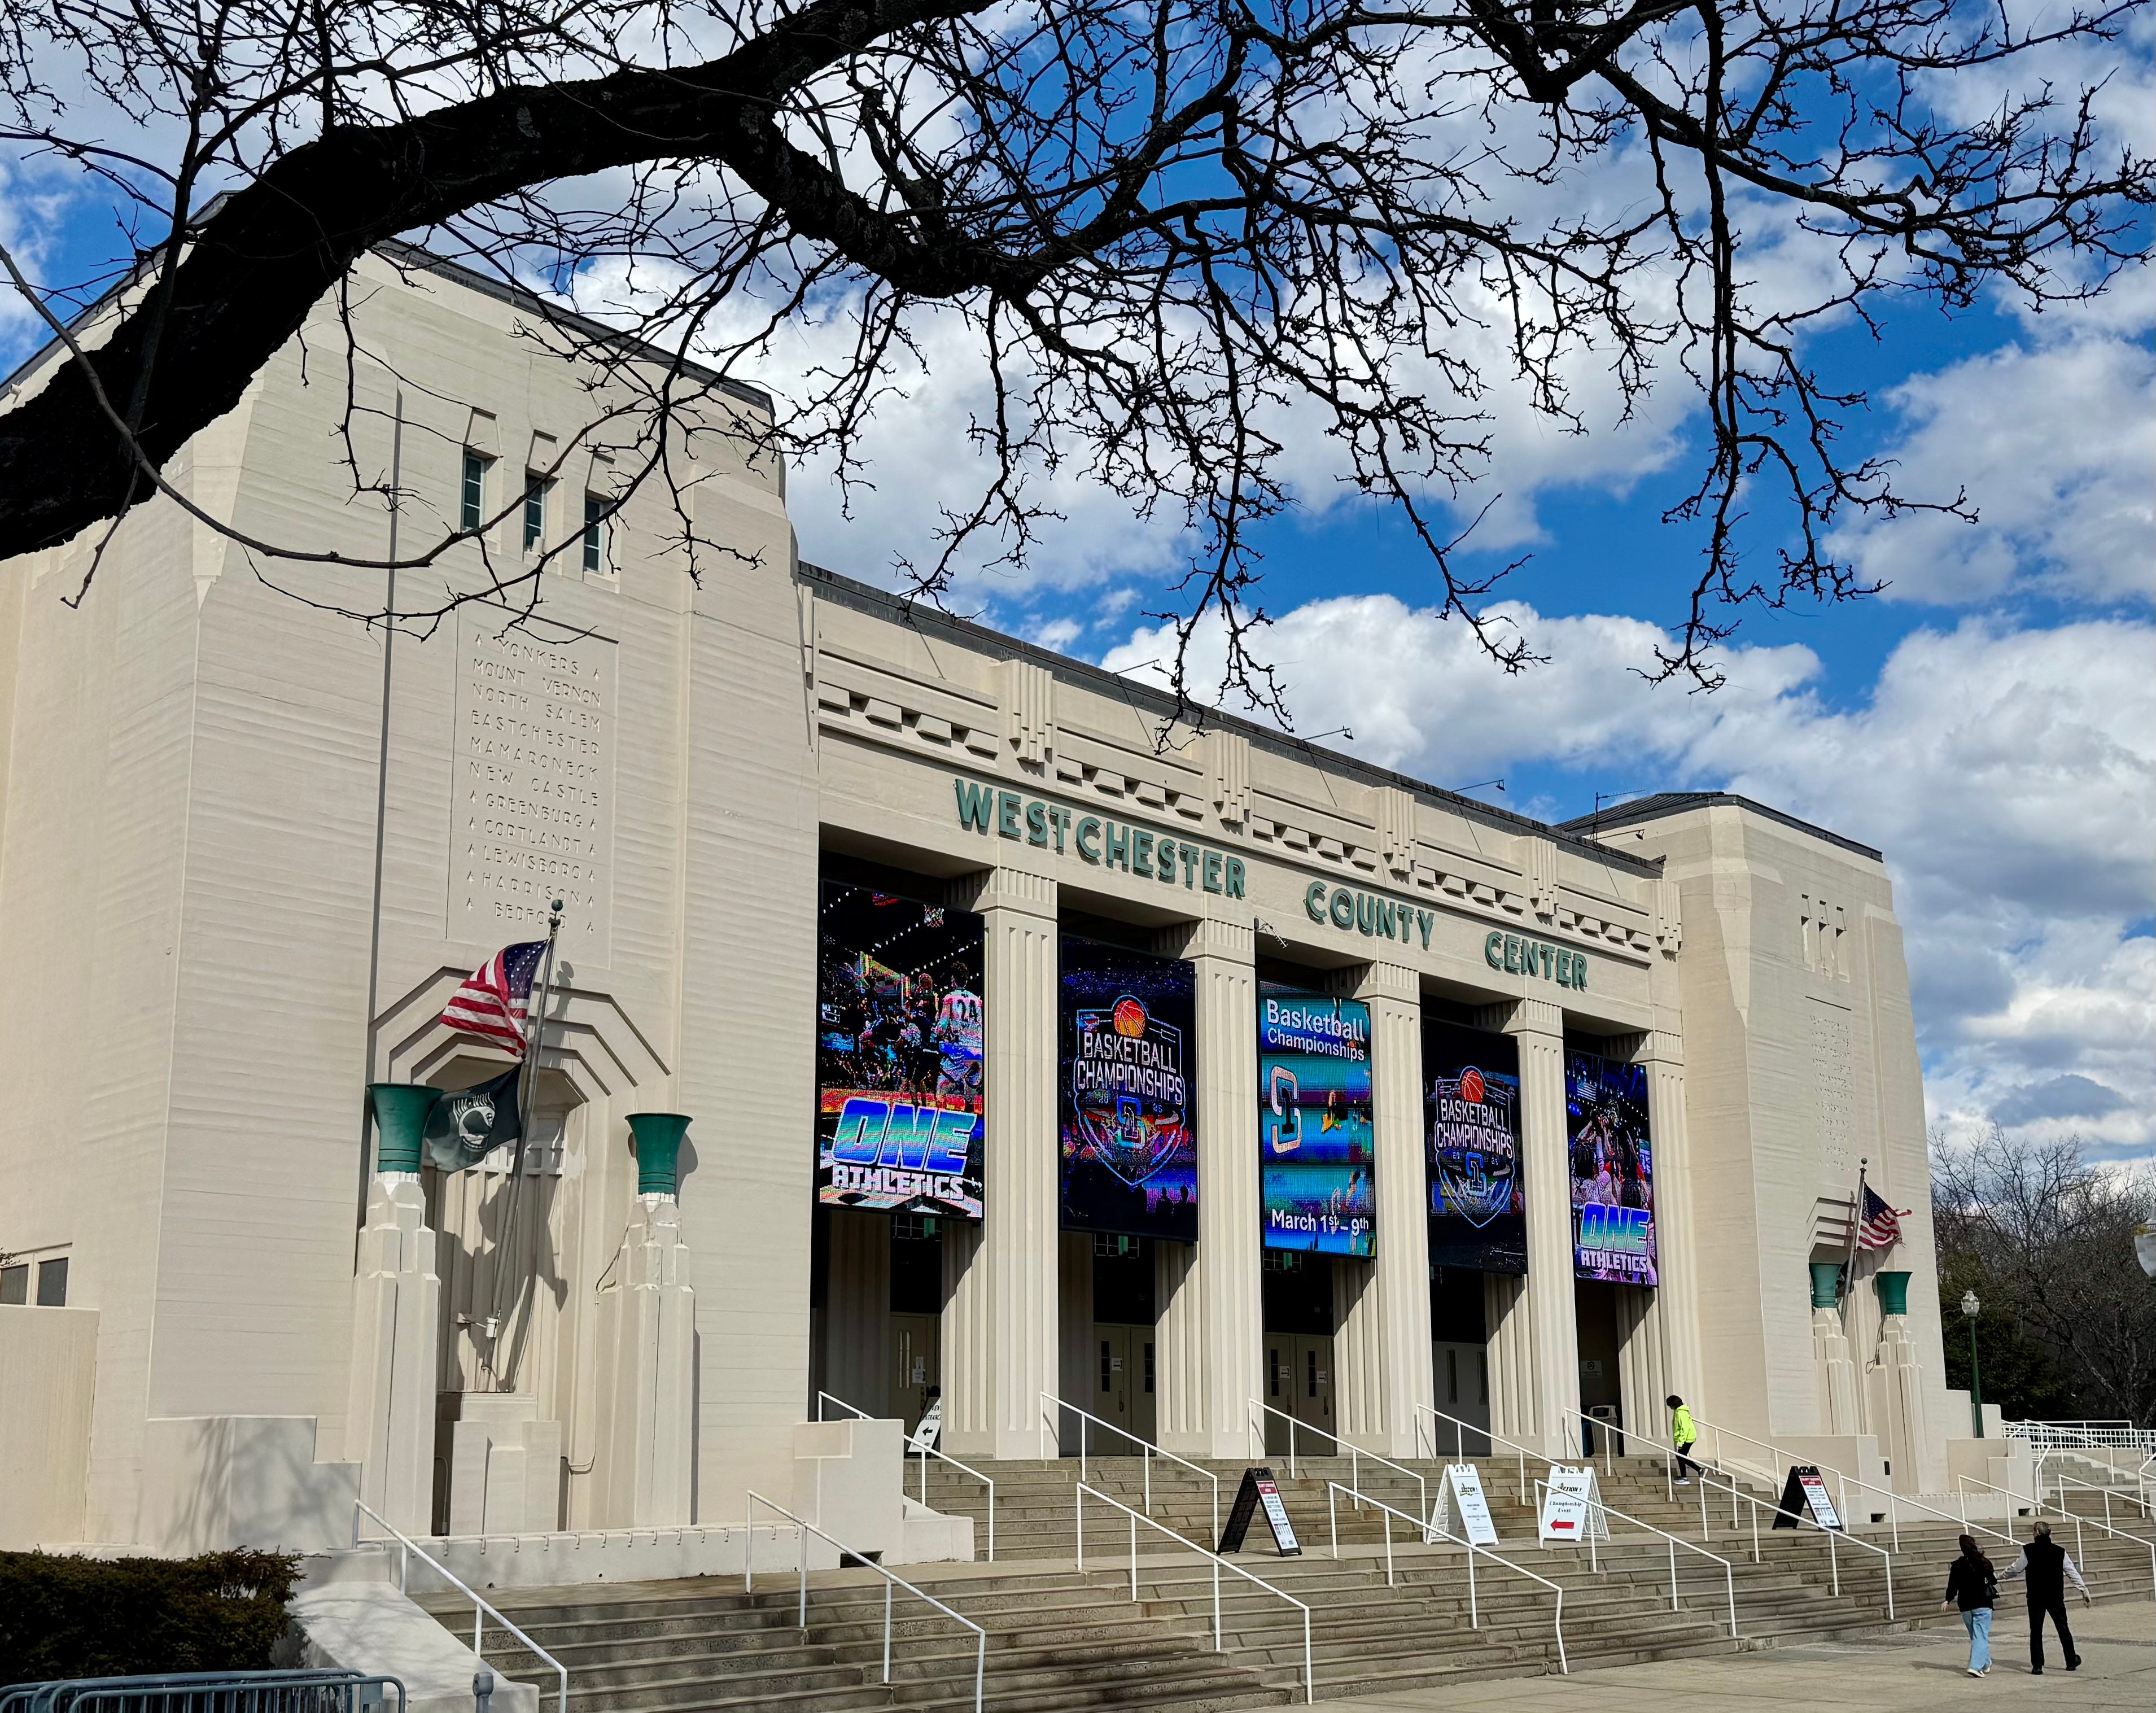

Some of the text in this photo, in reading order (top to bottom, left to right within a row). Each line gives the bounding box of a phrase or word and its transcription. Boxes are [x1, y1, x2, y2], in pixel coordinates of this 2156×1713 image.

[498, 639, 579, 675] YONKERS
[473, 658, 601, 707] MOUNT VERNON
[473, 683, 600, 733] NORTH SALEM
[471, 710, 600, 755] EASTCHESTER
[471, 736, 598, 782] MAMARONECK
[470, 762, 598, 806] NEW CASTLE
[486, 793, 582, 827] GREENBURG
[485, 819, 581, 854] CORTLANDT
[484, 846, 581, 879] LEWISBORO
[483, 872, 580, 906] HARRISON
[955, 778, 1588, 988] WESTCHESTER COUNTY CENTER
[1266, 999, 1365, 1042] Basketball
[1084, 1032, 1177, 1073] BASKETBALL
[1267, 1027, 1365, 1063] Championships
[1077, 1060, 1183, 1105] CHAMPIONSHIPS
[1441, 1099, 1507, 1132] BASKETBALL
[832, 1096, 978, 1175] ONE
[1437, 1122, 1513, 1159] CHAMPIONSHIPS
[832, 1164, 964, 1200] ATHLETICS
[1271, 1209, 1317, 1231] March
[1580, 1201, 1651, 1256] ONE
[1581, 1249, 1648, 1273] ATHLETICS
